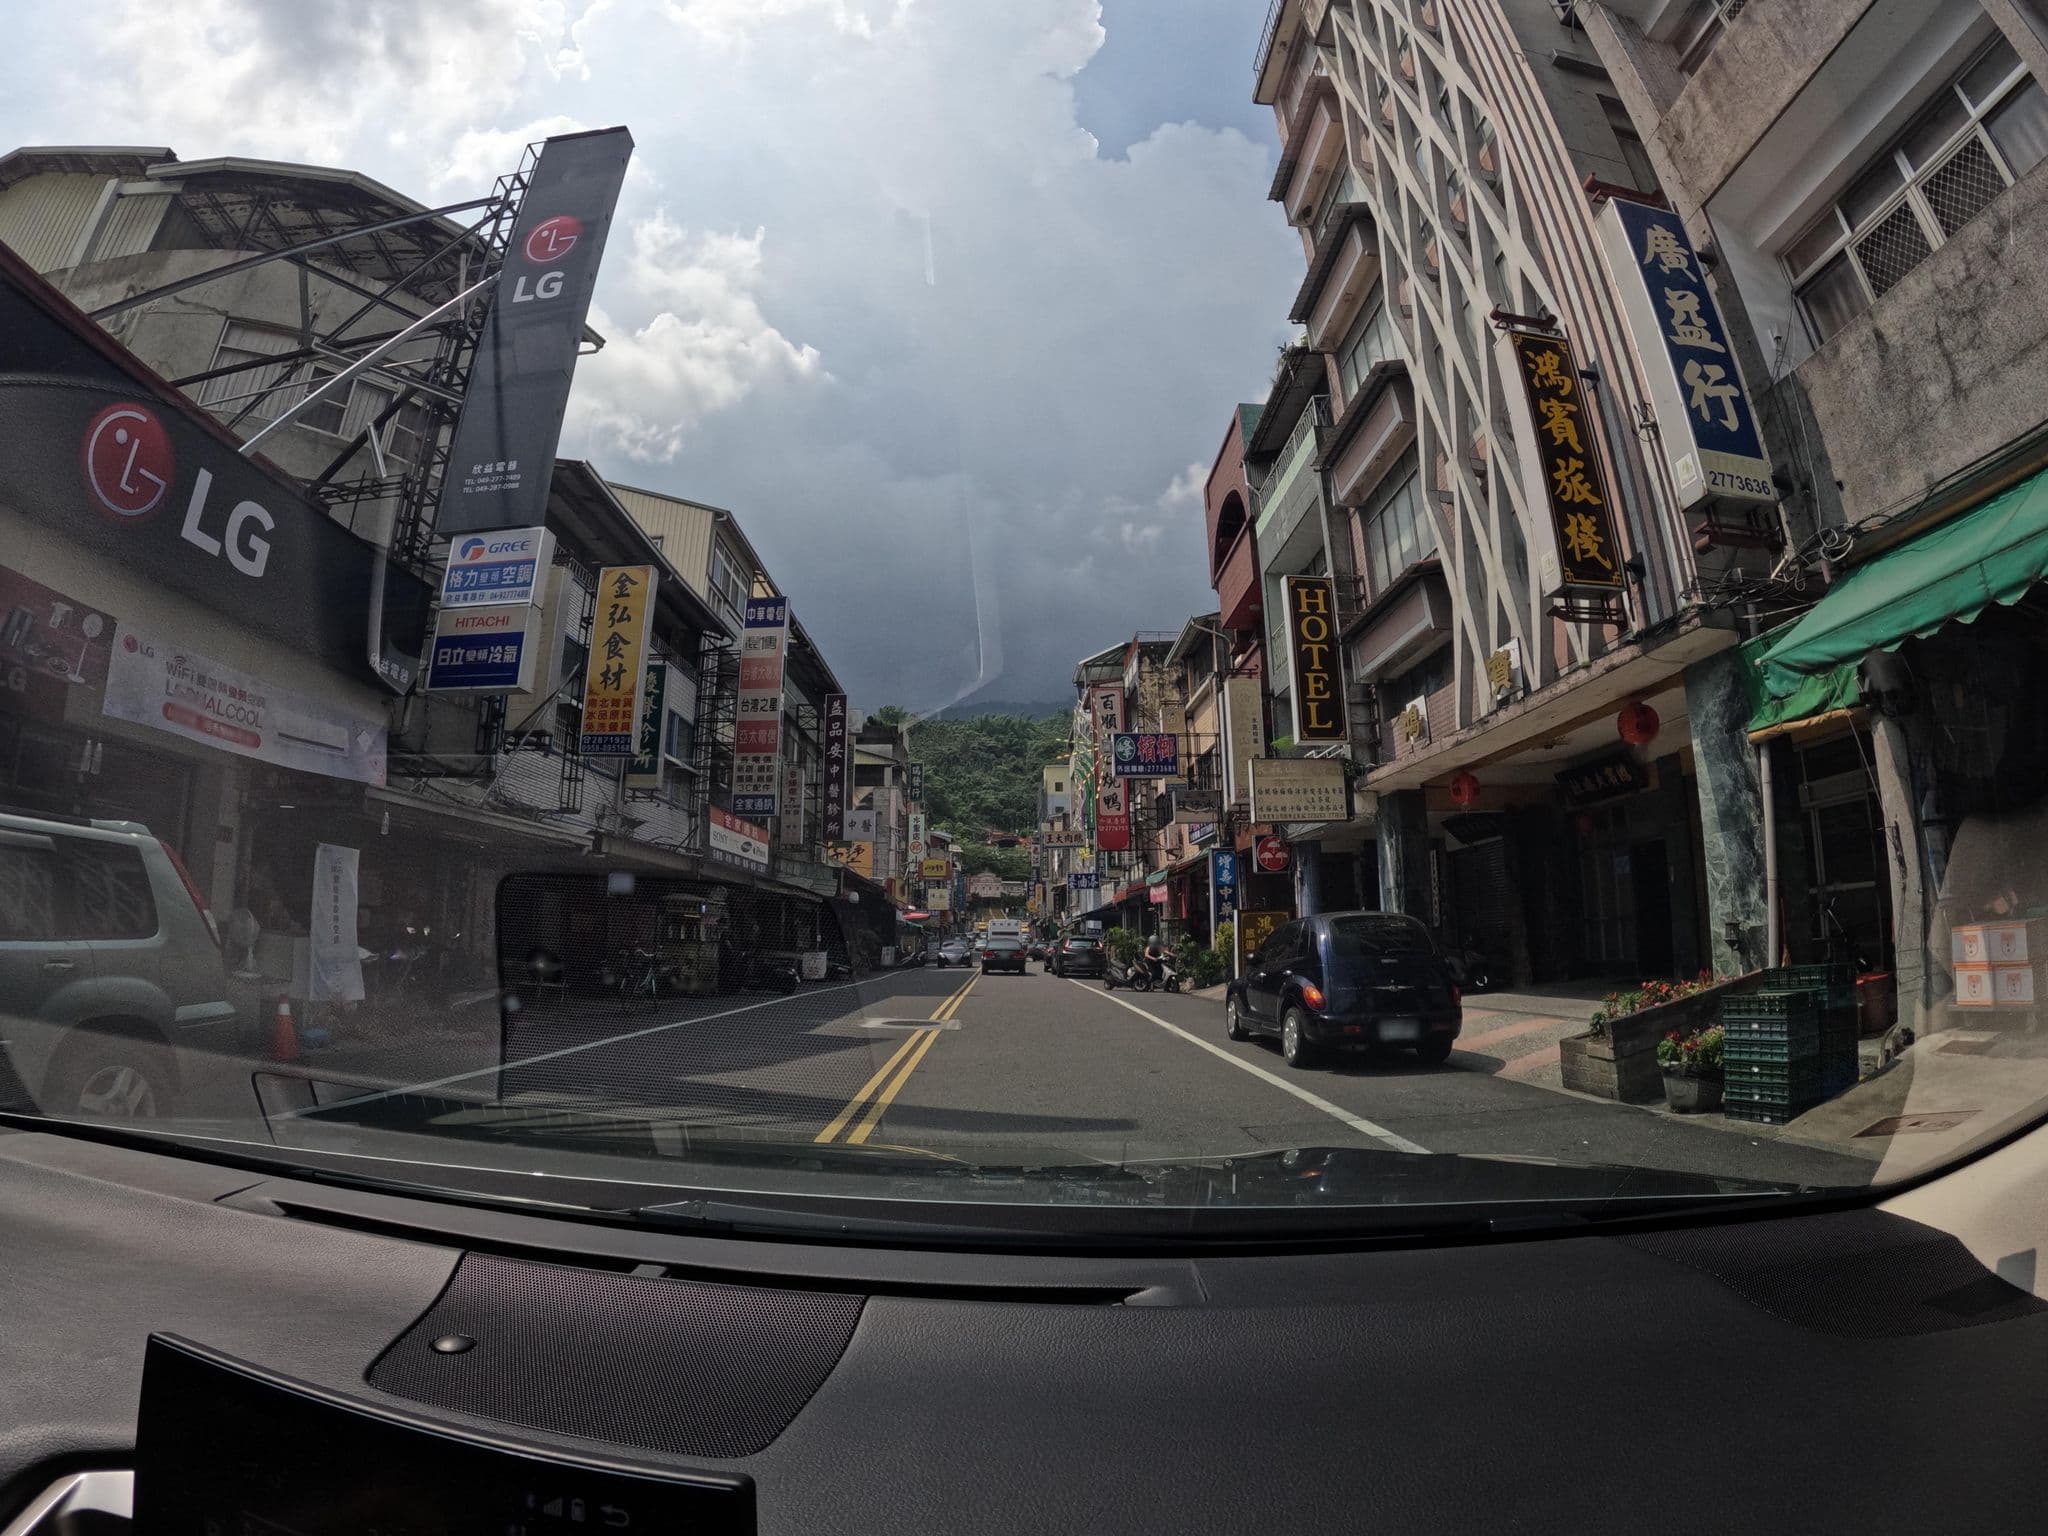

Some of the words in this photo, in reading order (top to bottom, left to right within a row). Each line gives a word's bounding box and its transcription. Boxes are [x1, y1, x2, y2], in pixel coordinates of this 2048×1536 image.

[512, 270, 566, 304] LG
[1526, 350, 1613, 570] 鴻賓旅棧
[1709, 469, 1771, 496] 2773636
[181, 466, 276, 578] LG
[488, 540, 532, 554] GREE
[449, 563, 534, 588] 格力變頻空調
[455, 615, 510, 629] HITACHI
[746, 605, 785, 621] 中華電信
[599, 571, 639, 692] 金弘食材
[140, 641, 155, 659] LG
[437, 645, 518, 667] 日立變頻冷氣
[1297, 588, 1333, 729] HOTEL
[741, 697, 778, 713] 台灣之星
[737, 728, 777, 744] 亞太電信
[826, 699, 845, 836] 益品安中醫診所
[735, 798, 774, 811] 全家通訊
[848, 818, 873, 833] 中醫
